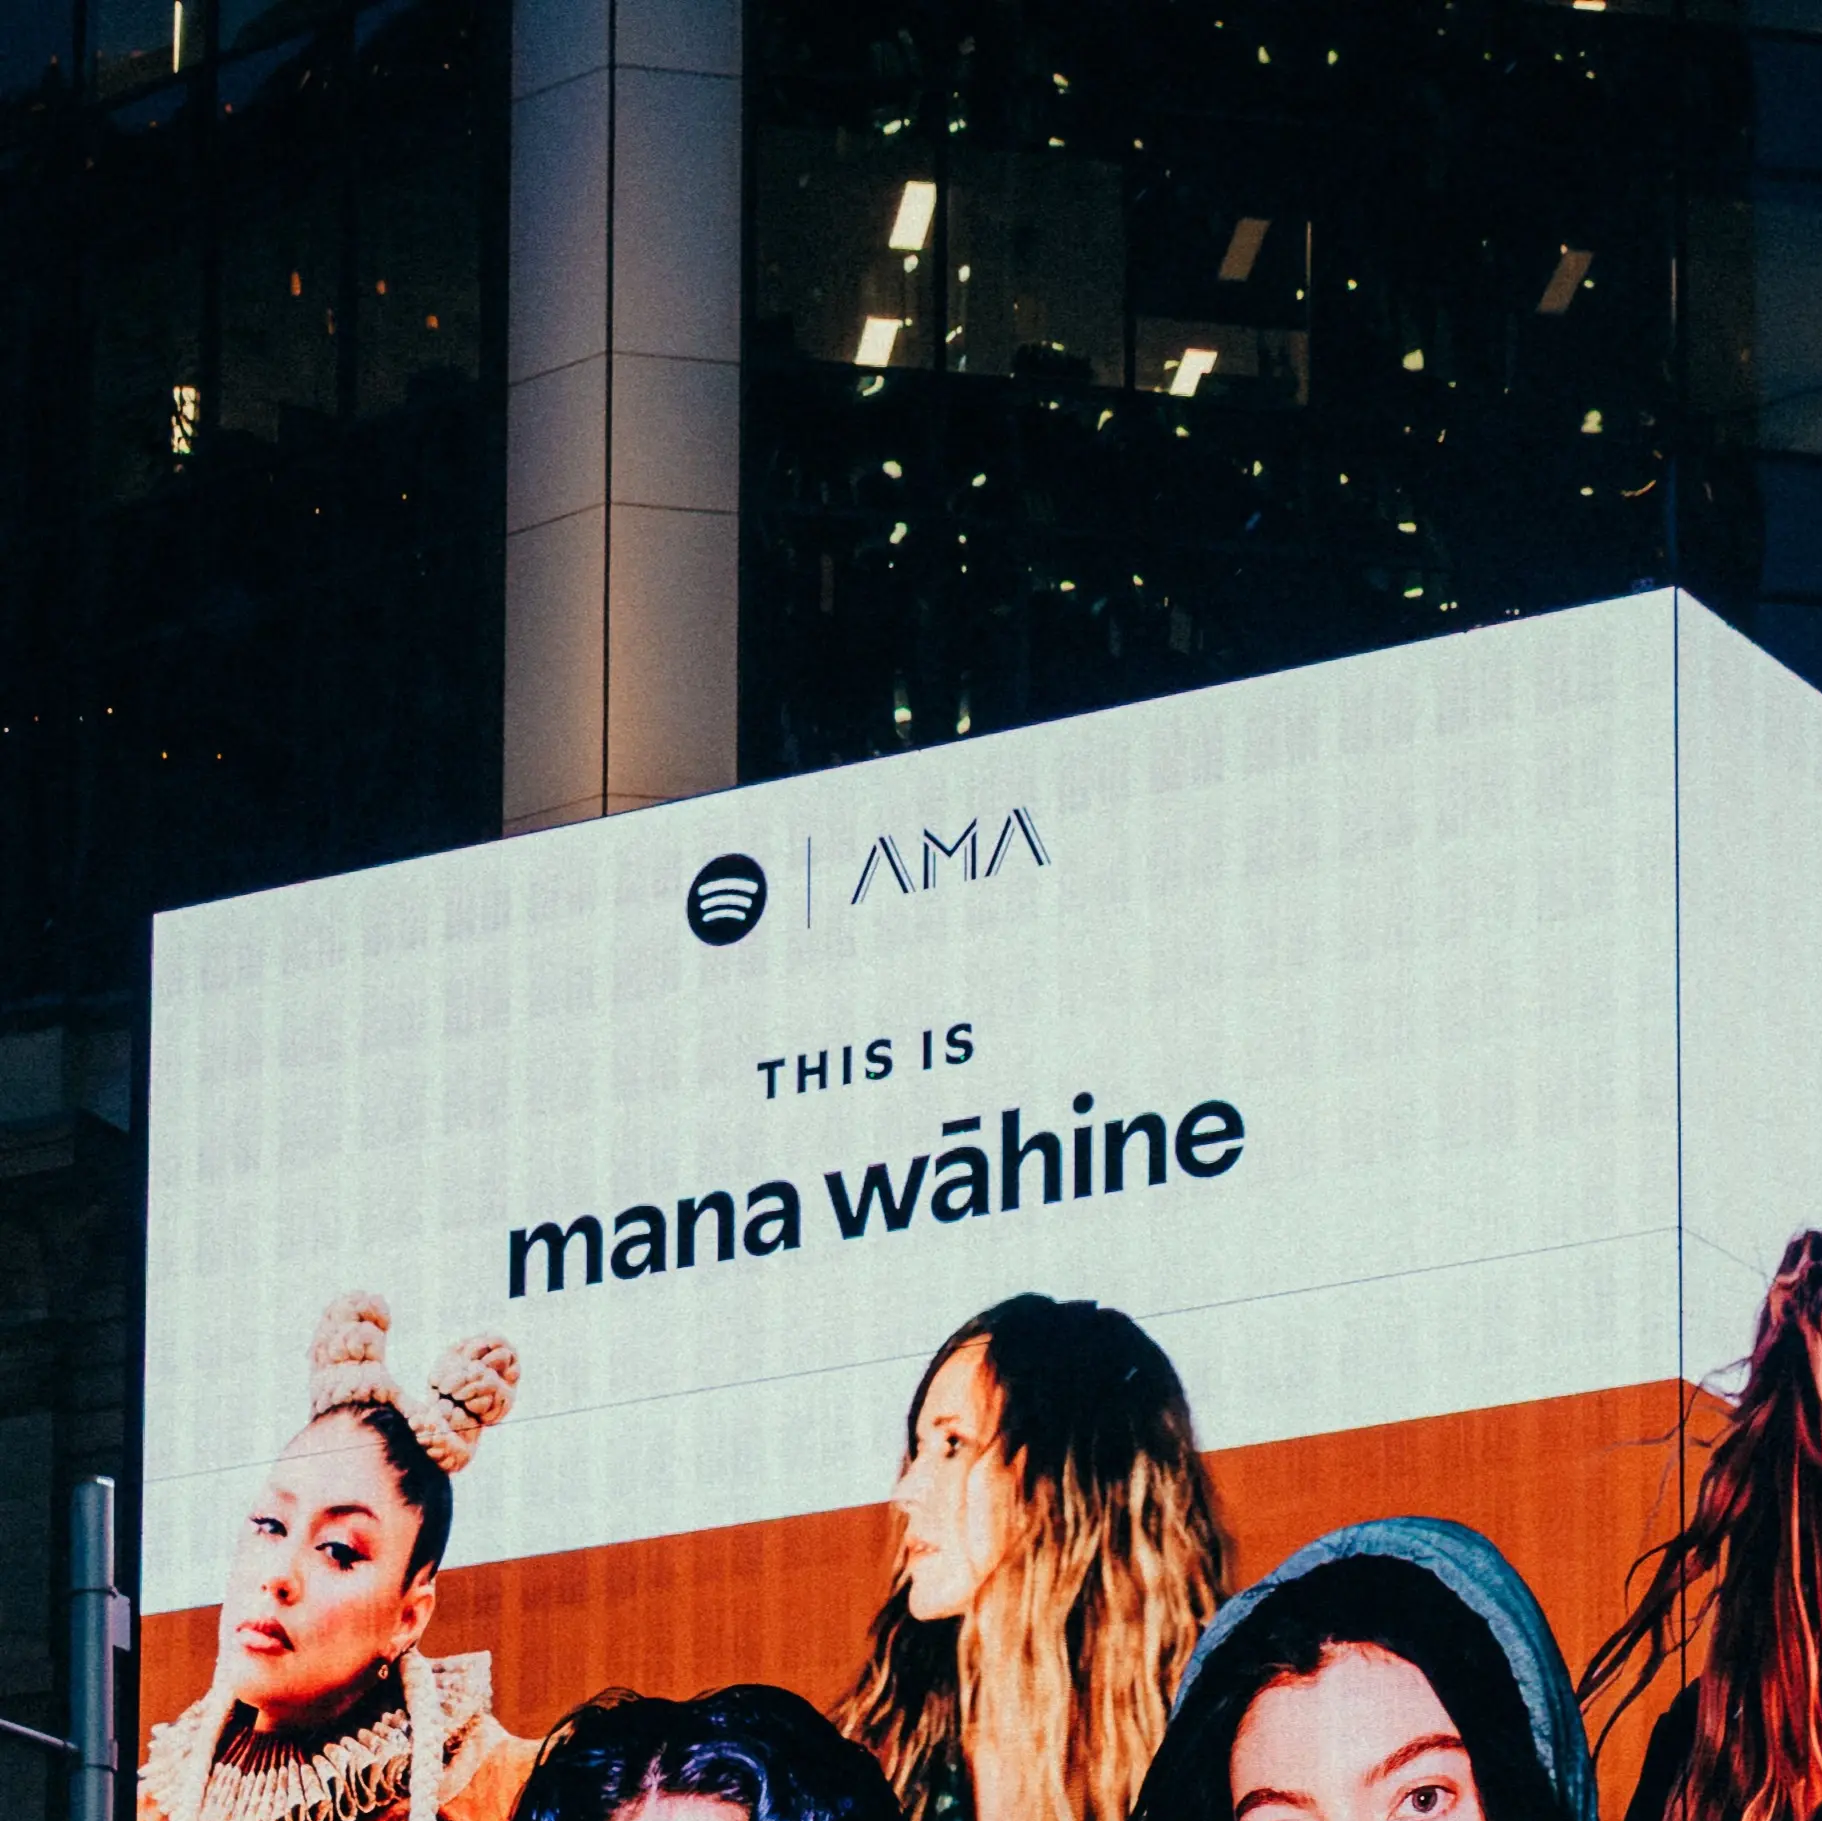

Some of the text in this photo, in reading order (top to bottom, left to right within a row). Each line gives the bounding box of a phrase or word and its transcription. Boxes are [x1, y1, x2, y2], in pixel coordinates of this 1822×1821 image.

[850, 807, 1052, 906] AMA
[757, 1023, 976, 1099] THIS IS
[508, 1091, 1246, 1299] mana wāhine
